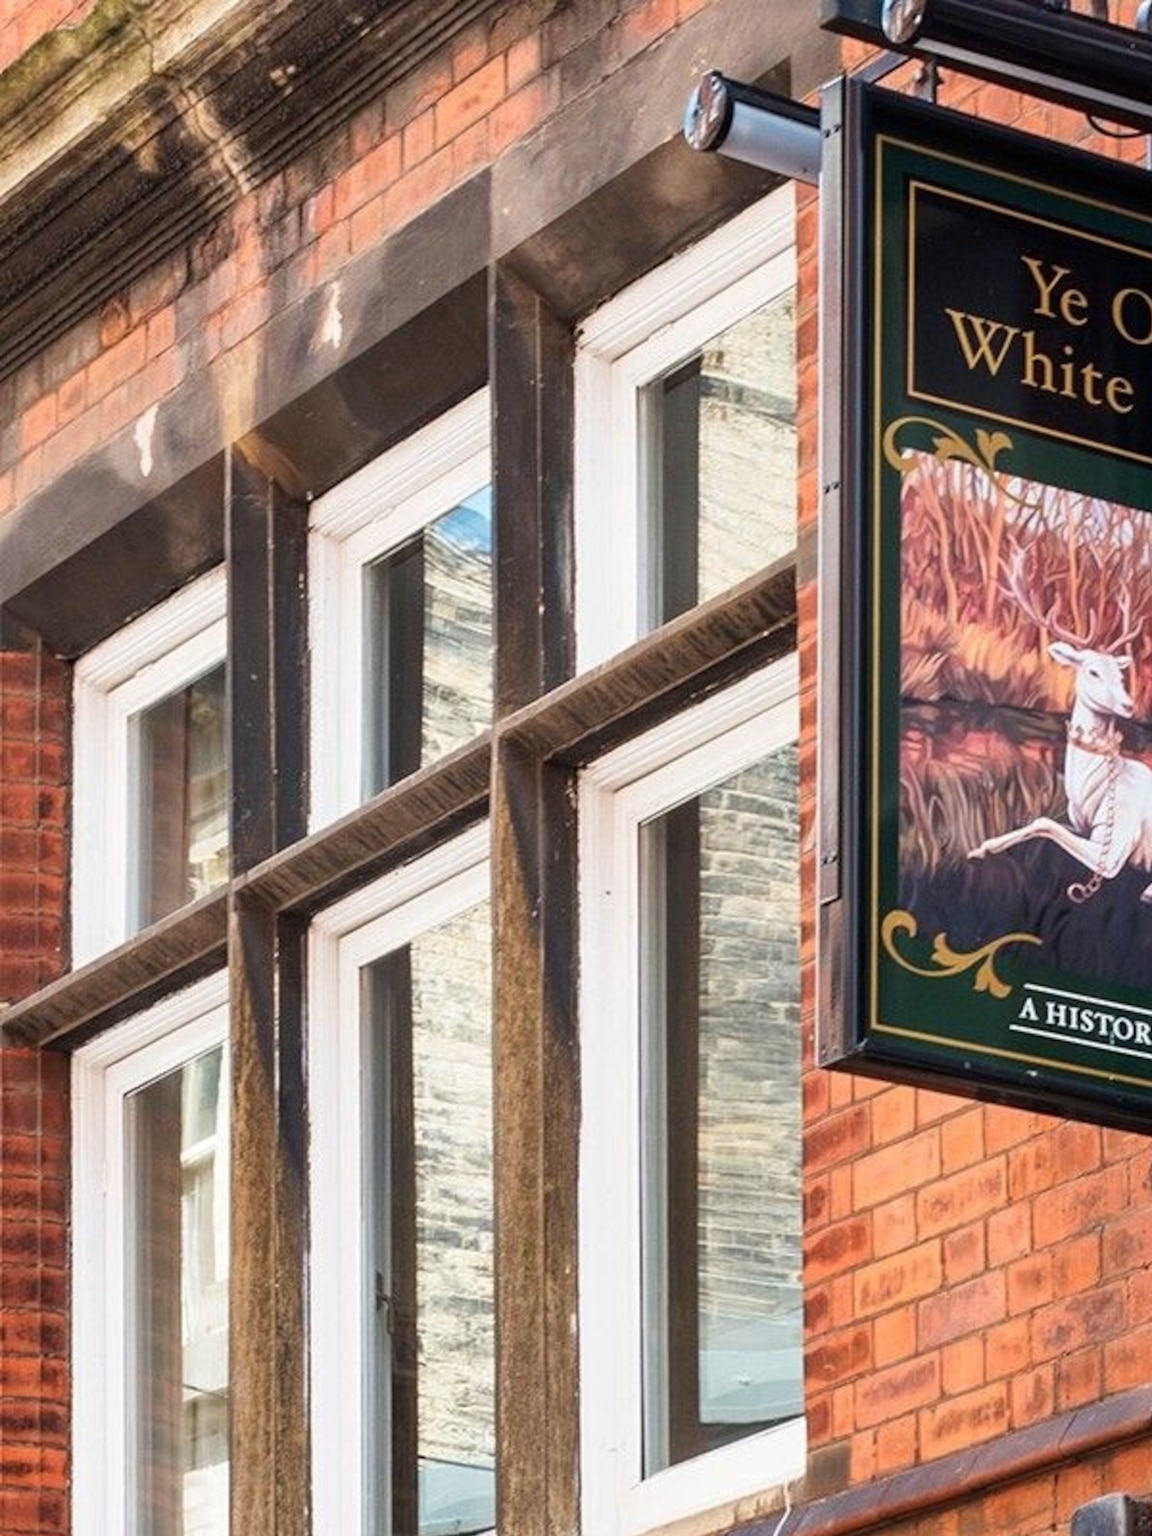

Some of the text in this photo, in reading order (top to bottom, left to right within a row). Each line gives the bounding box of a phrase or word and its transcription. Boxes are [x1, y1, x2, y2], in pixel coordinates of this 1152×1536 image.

[1021, 254, 1089, 327] Ye
[945, 307, 1135, 414] White
[1018, 997, 1039, 1022] A
